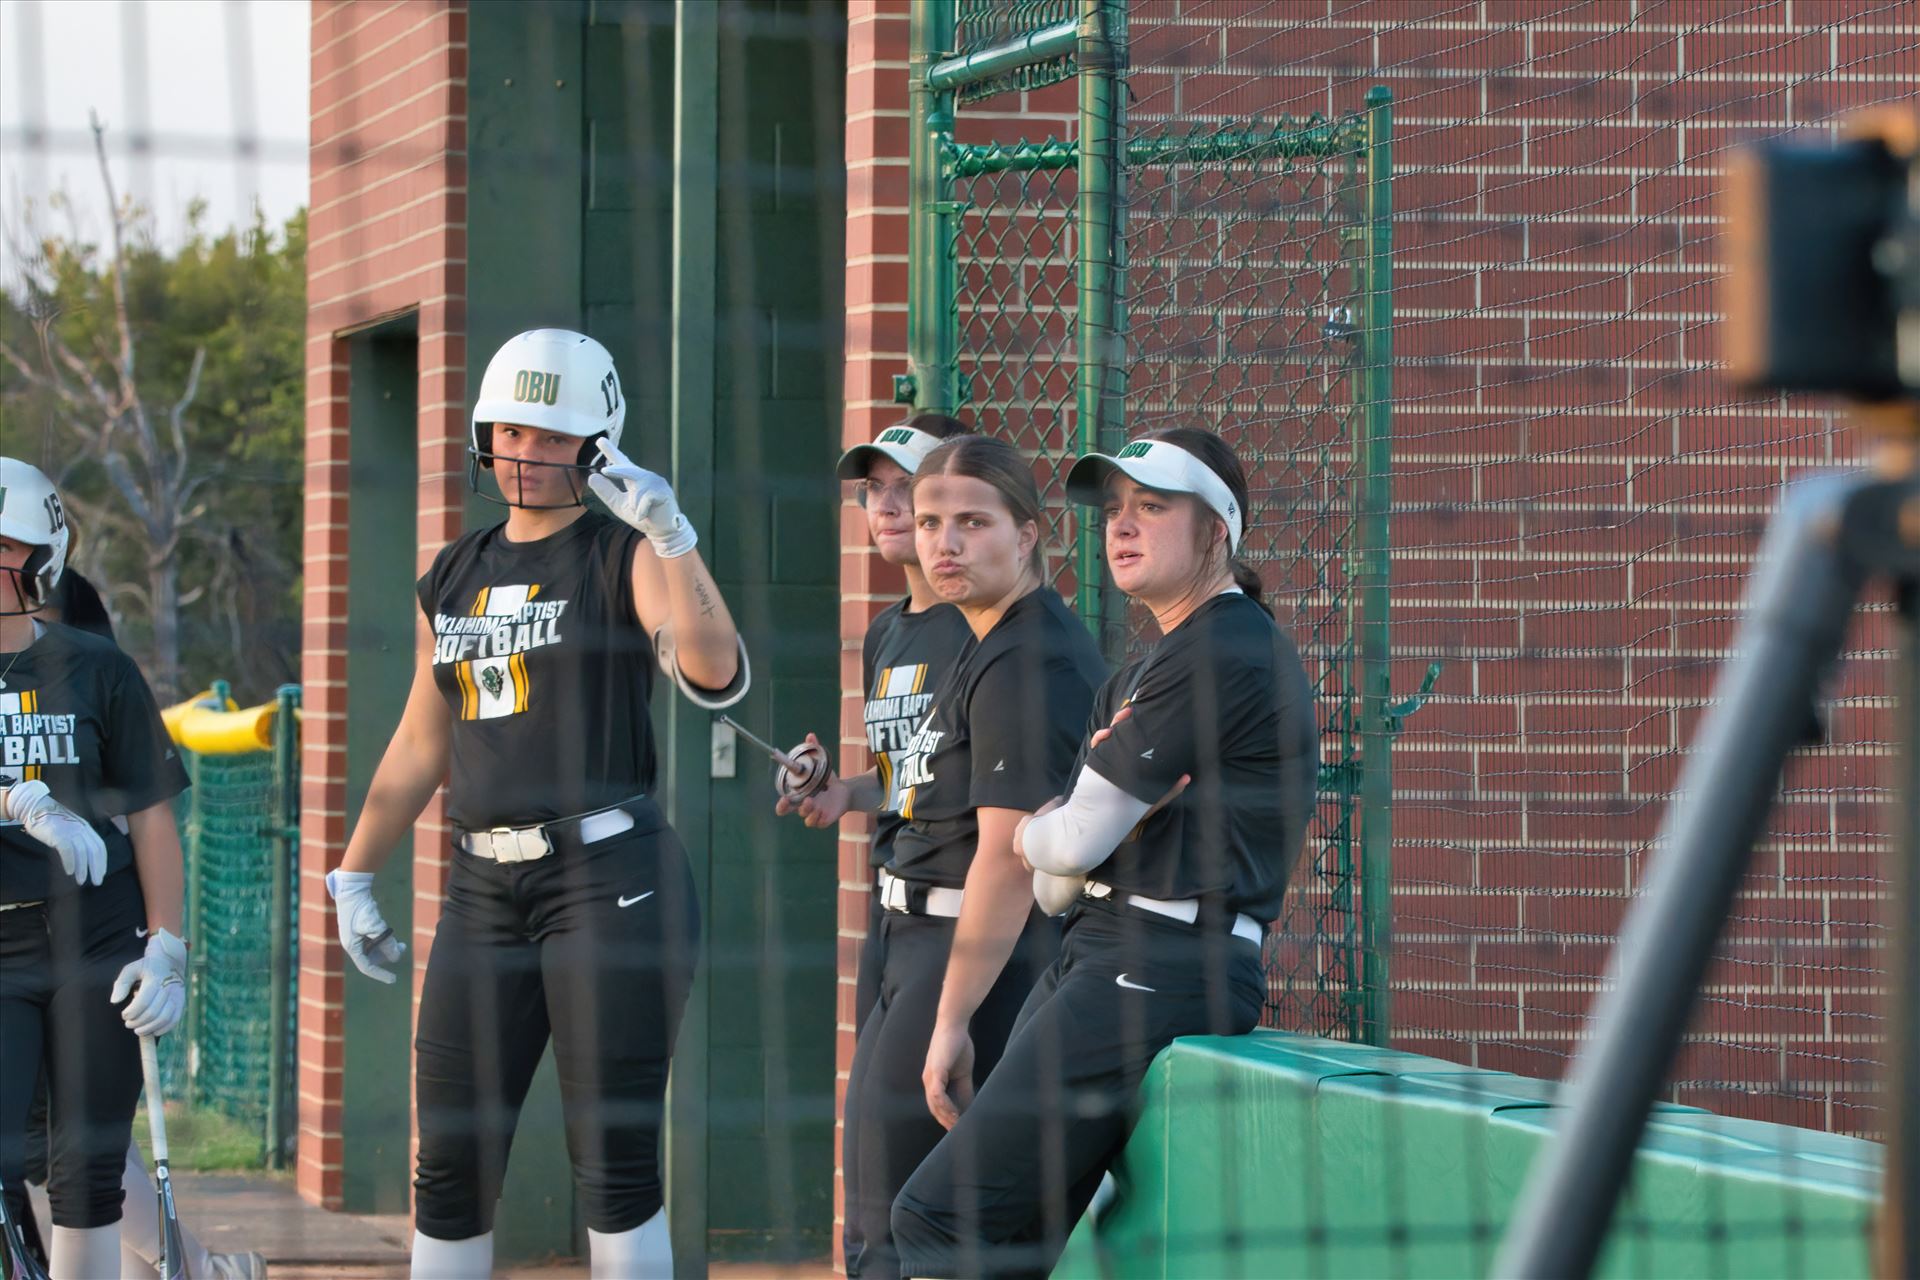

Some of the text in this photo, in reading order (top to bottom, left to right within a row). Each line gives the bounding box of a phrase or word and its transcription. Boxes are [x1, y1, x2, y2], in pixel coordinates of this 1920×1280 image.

[514, 370, 562, 406] OBU
[601, 371, 619, 417] 17
[43, 493, 64, 534] 16
[500, 600, 569, 624] APTIST
[12, 714, 75, 735] BAPTIST
[0, 735, 80, 765] BALL
